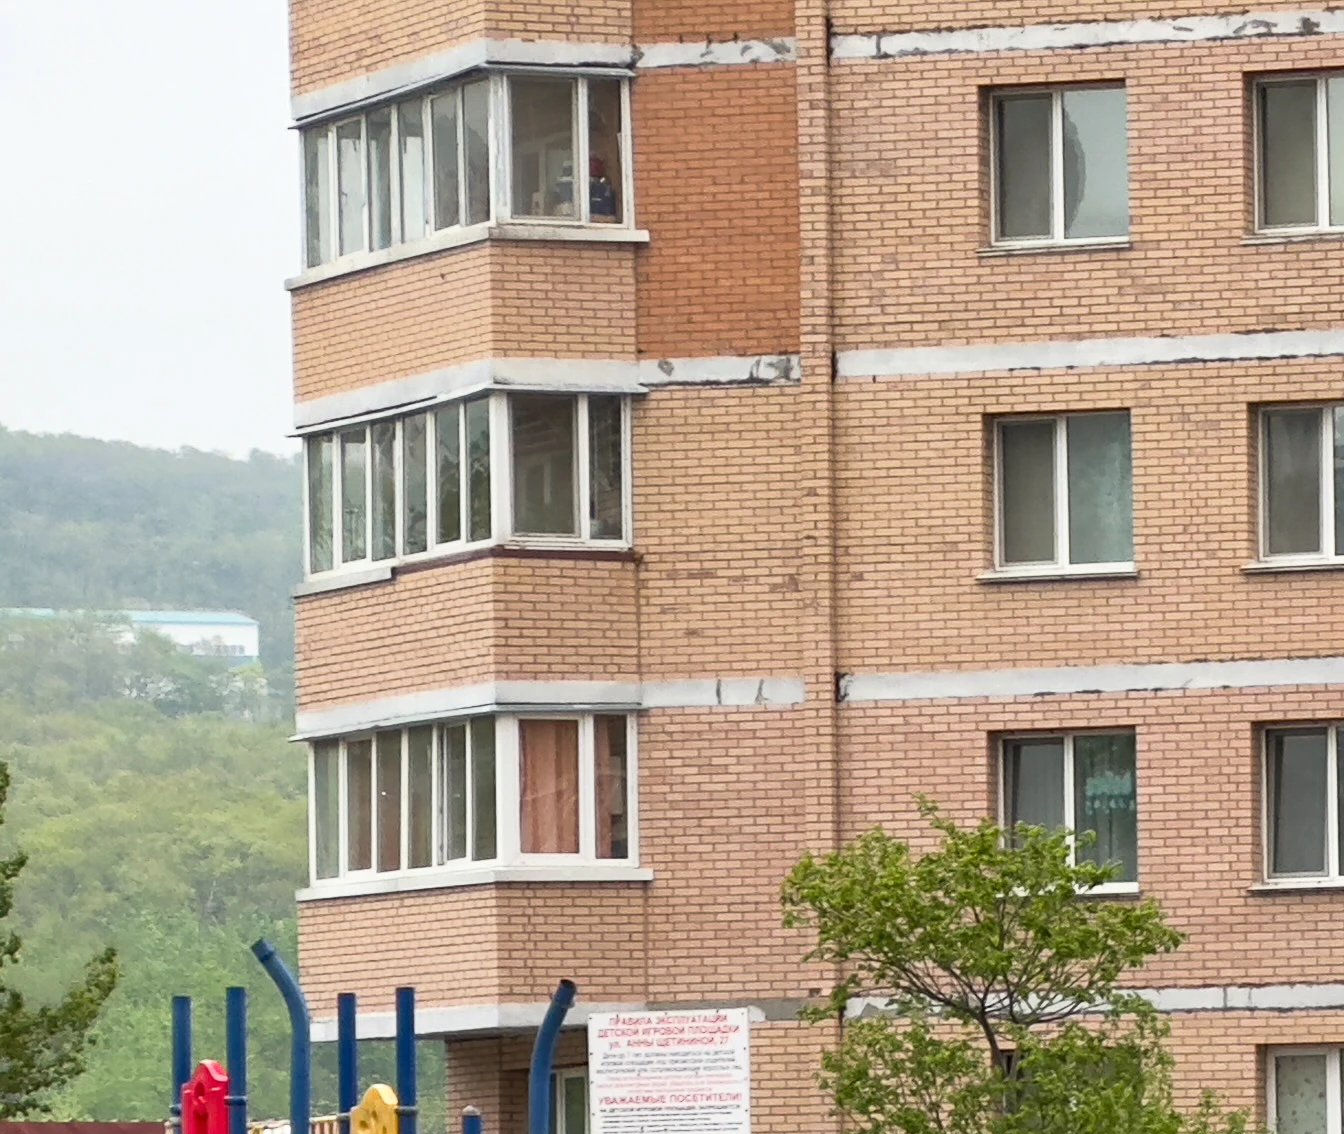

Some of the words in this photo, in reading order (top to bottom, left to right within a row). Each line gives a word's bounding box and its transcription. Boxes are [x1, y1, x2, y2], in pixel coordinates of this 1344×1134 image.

[609, 1015, 652, 1026] ПРАВИЛА
[655, 1014, 728, 1025] ЭКСПЛУАТАЦИИ
[597, 1027, 639, 1038] ДЕТСКОЙ
[642, 1026, 685, 1036] ИГРОВОЙ
[688, 1024, 740, 1035] ПЛОЩАДКИ
[626, 1038, 653, 1048] АННЫ
[599, 1094, 666, 1106] УВАЖАЕМЫЕ
[669, 1092, 742, 1103] ПОСЕТИТЕЛИ!
